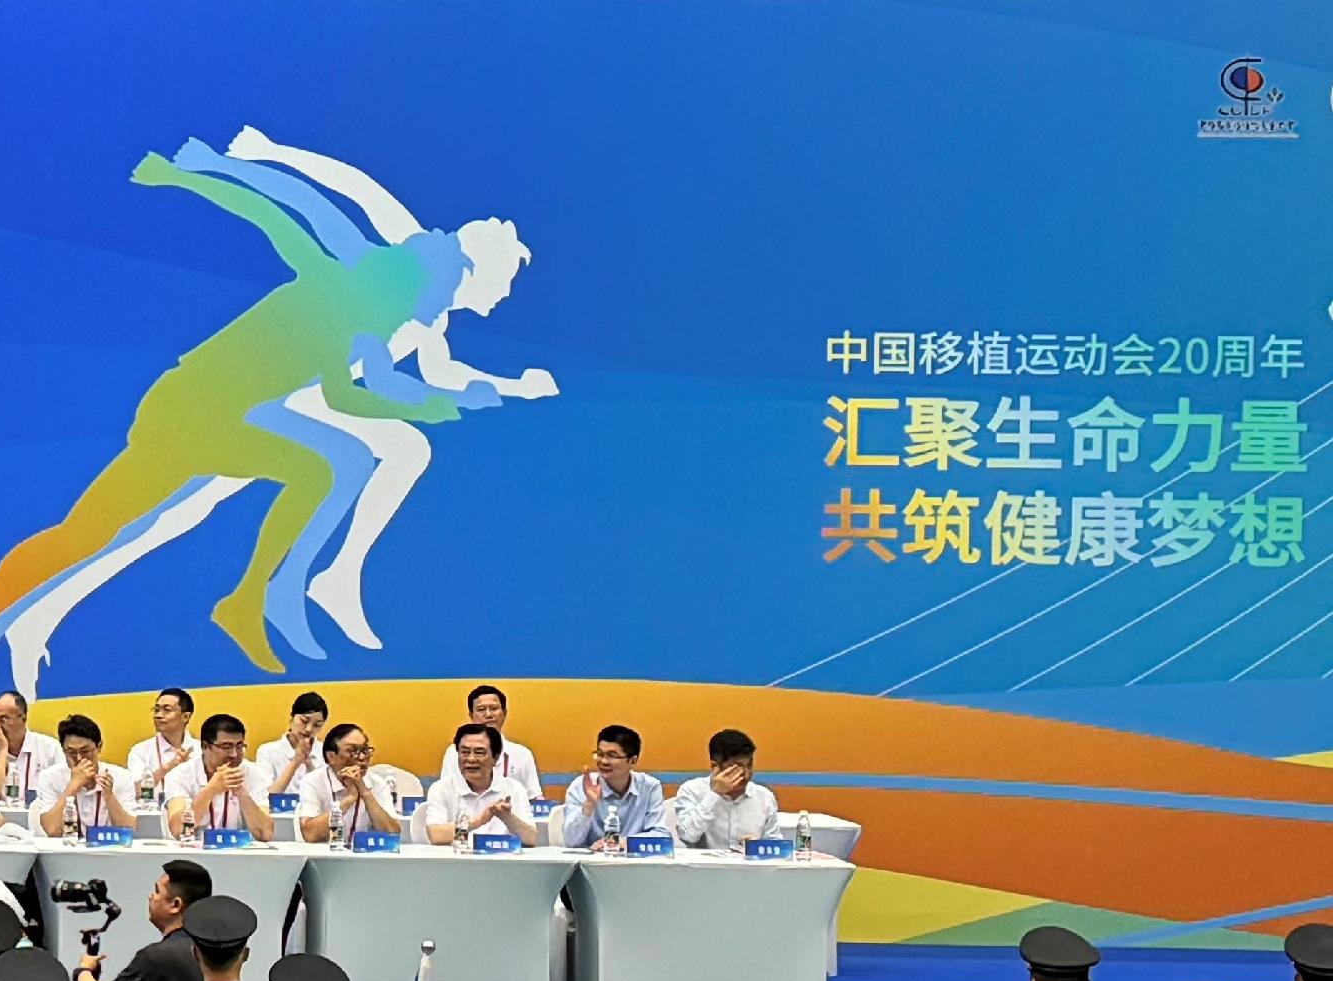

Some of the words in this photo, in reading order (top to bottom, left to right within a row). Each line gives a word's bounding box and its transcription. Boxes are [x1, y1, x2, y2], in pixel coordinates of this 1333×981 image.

[825, 329, 1306, 379] 中国移植运动会20周年
[822, 394, 1309, 474] 汇聚生命力量
[821, 487, 1307, 568] 共筑健康梦想
